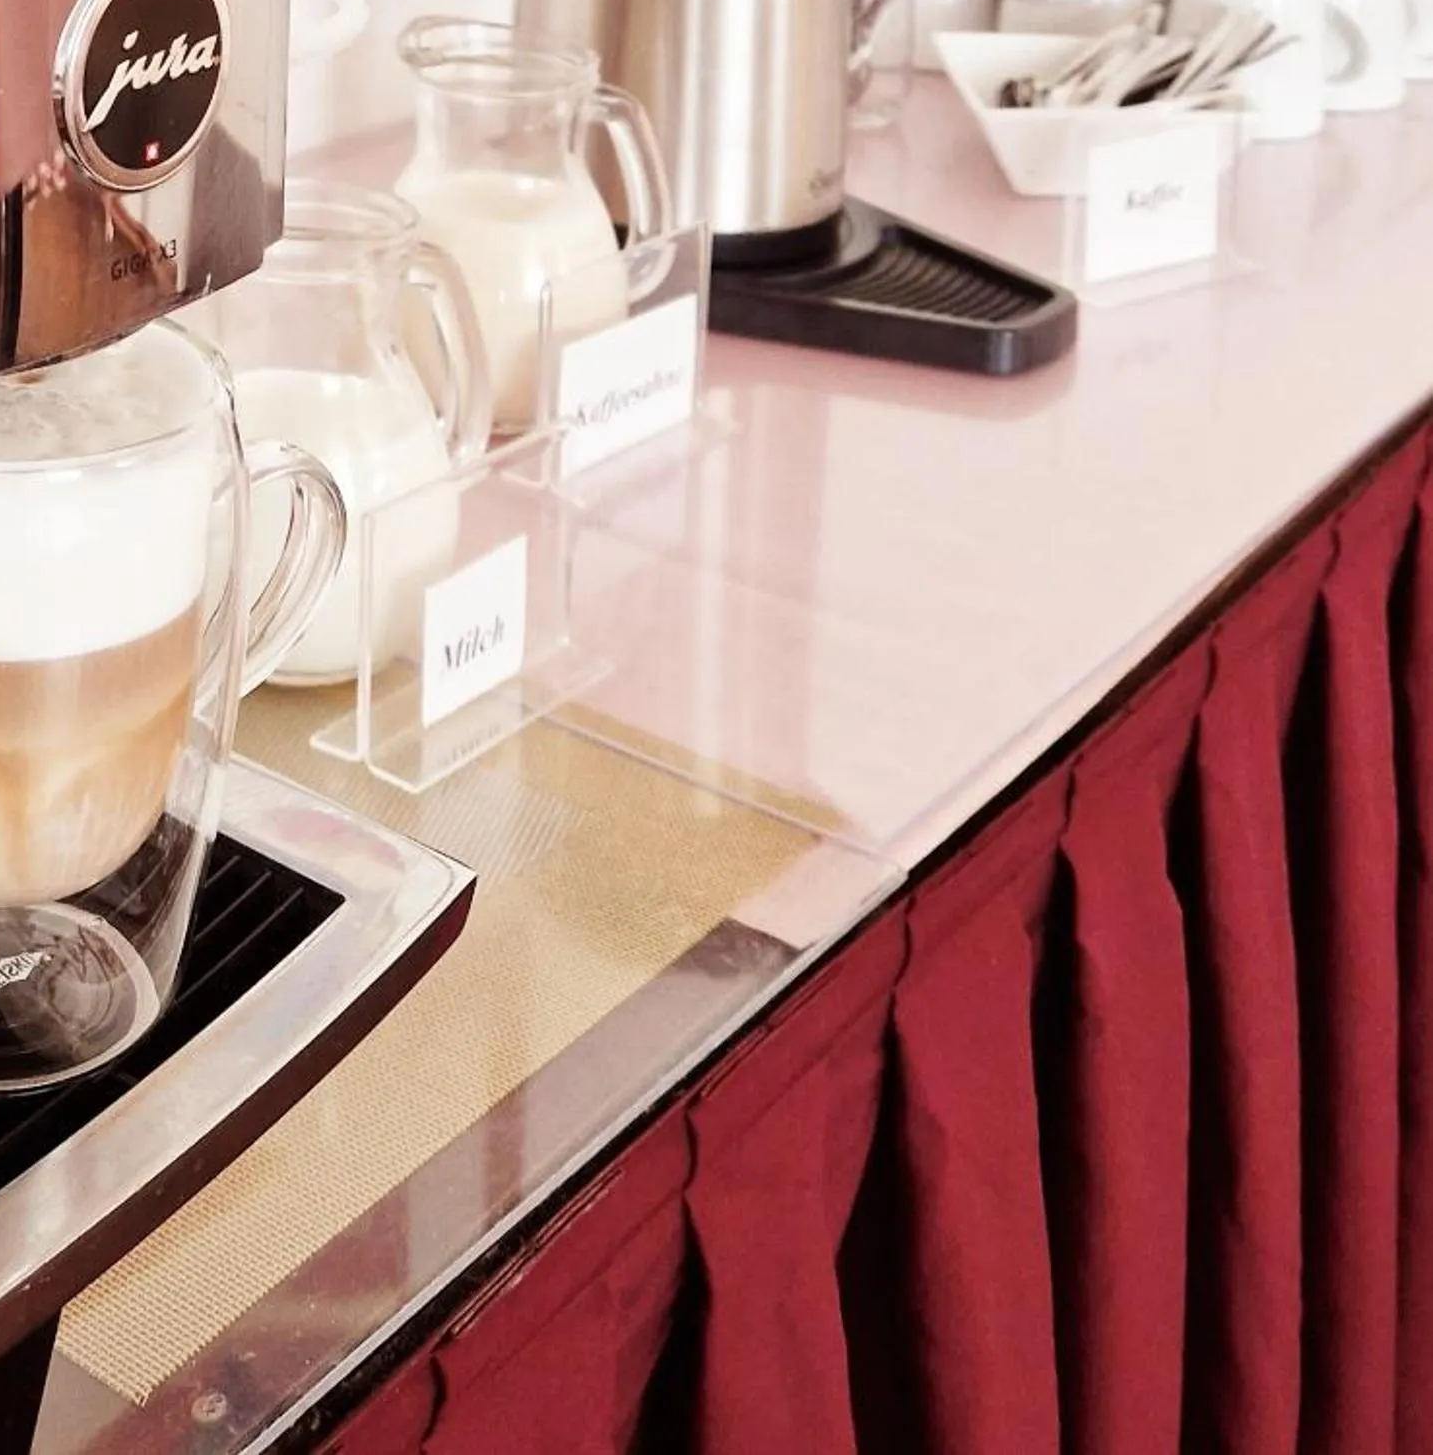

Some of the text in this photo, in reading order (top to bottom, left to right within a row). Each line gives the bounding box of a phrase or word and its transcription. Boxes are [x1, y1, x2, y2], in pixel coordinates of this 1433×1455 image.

[82, 28, 219, 133] jura
[1124, 182, 1184, 213] Kaffee
[110, 250, 152, 283] GIGA
[441, 614, 505, 673] Milch
